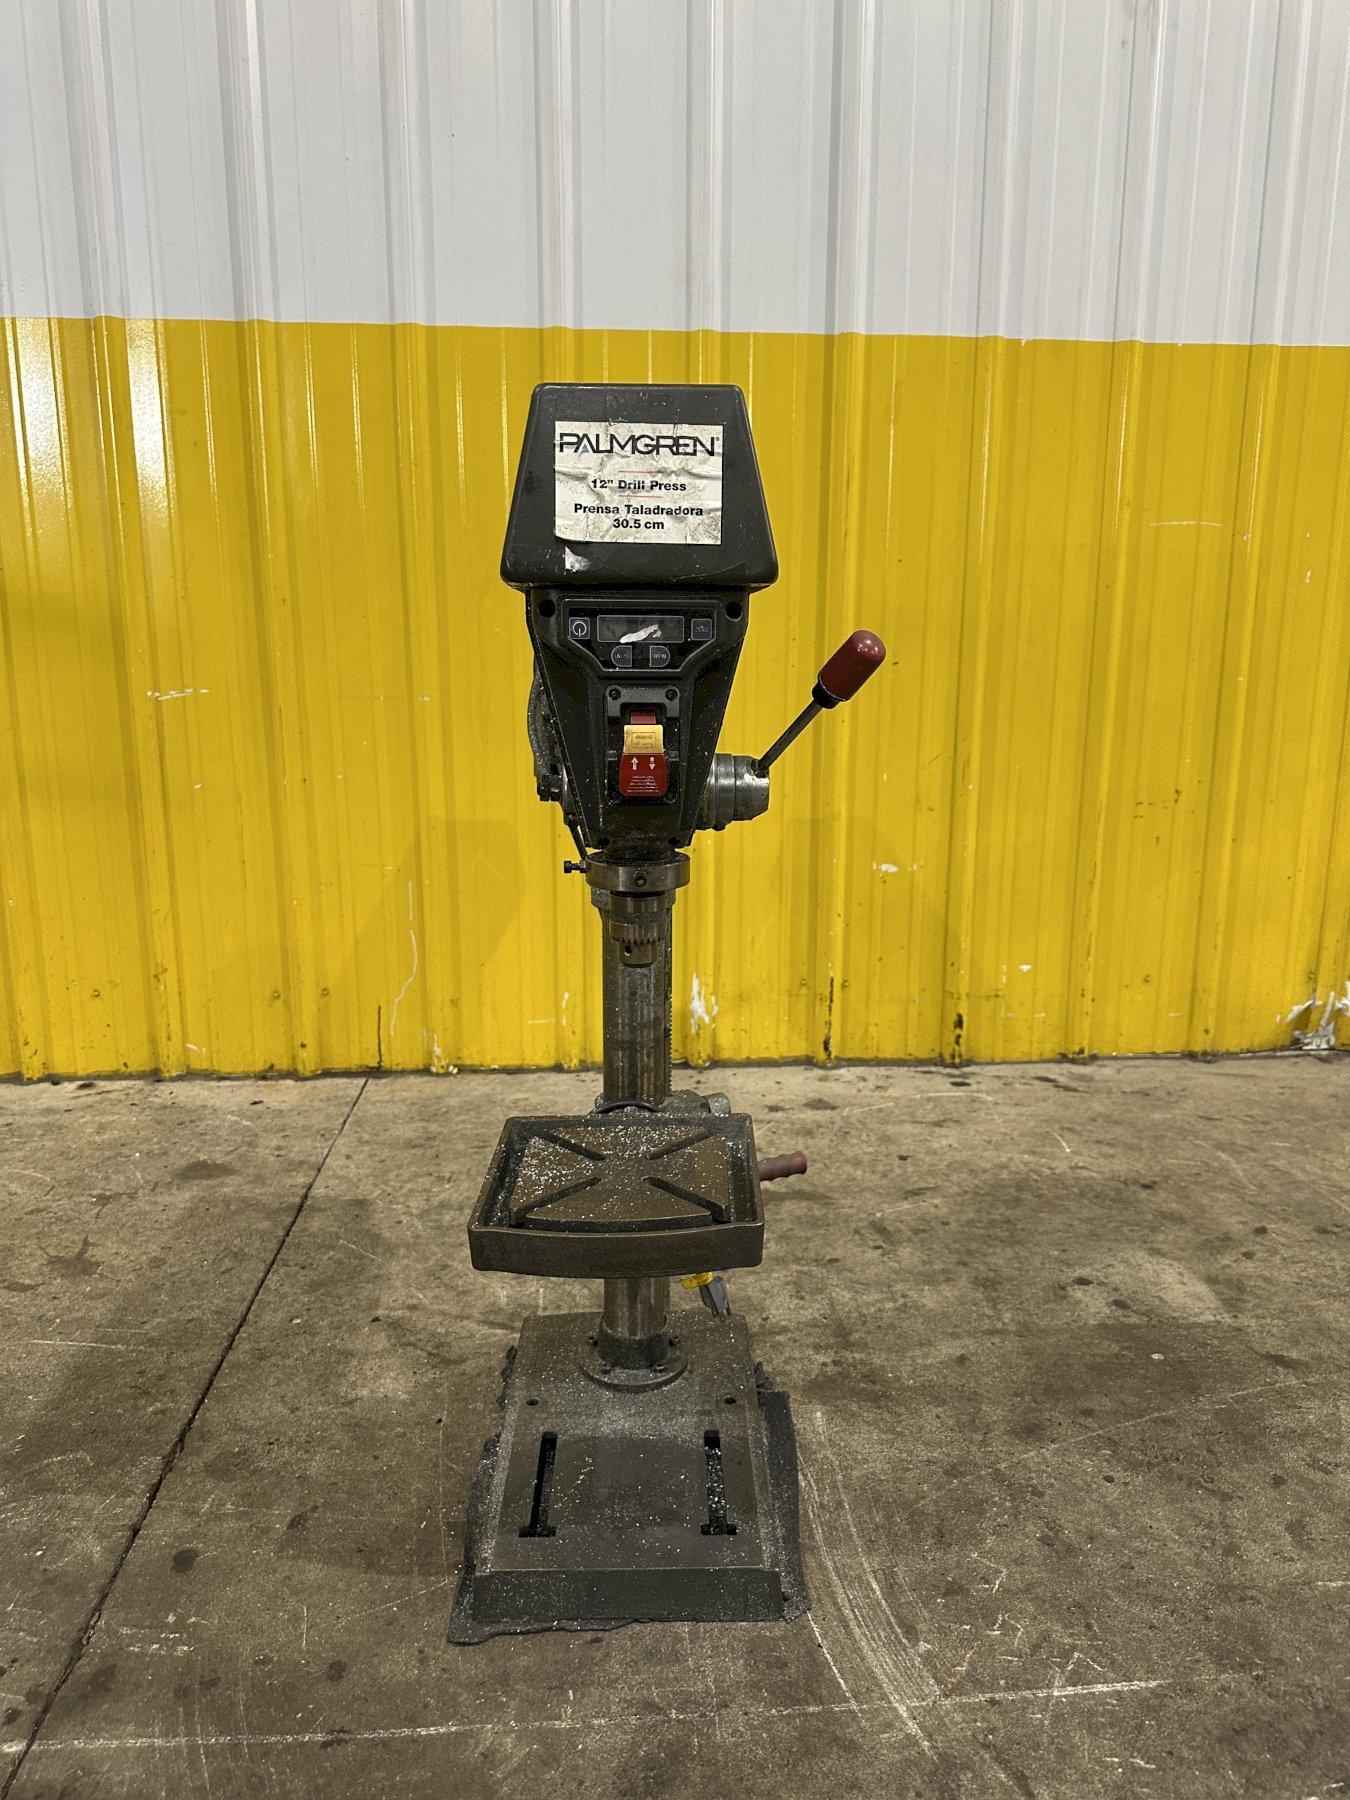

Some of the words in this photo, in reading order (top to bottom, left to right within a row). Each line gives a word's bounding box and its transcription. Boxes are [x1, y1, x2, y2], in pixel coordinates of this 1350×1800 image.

[591, 479, 613, 489] 12"
[618, 480, 645, 490] Drill
[650, 480, 687, 491] Press
[574, 503, 620, 514] Prensa
[625, 504, 703, 516] Taladradora
[612, 518, 641, 529] 30.5
[644, 519, 665, 530] cm
